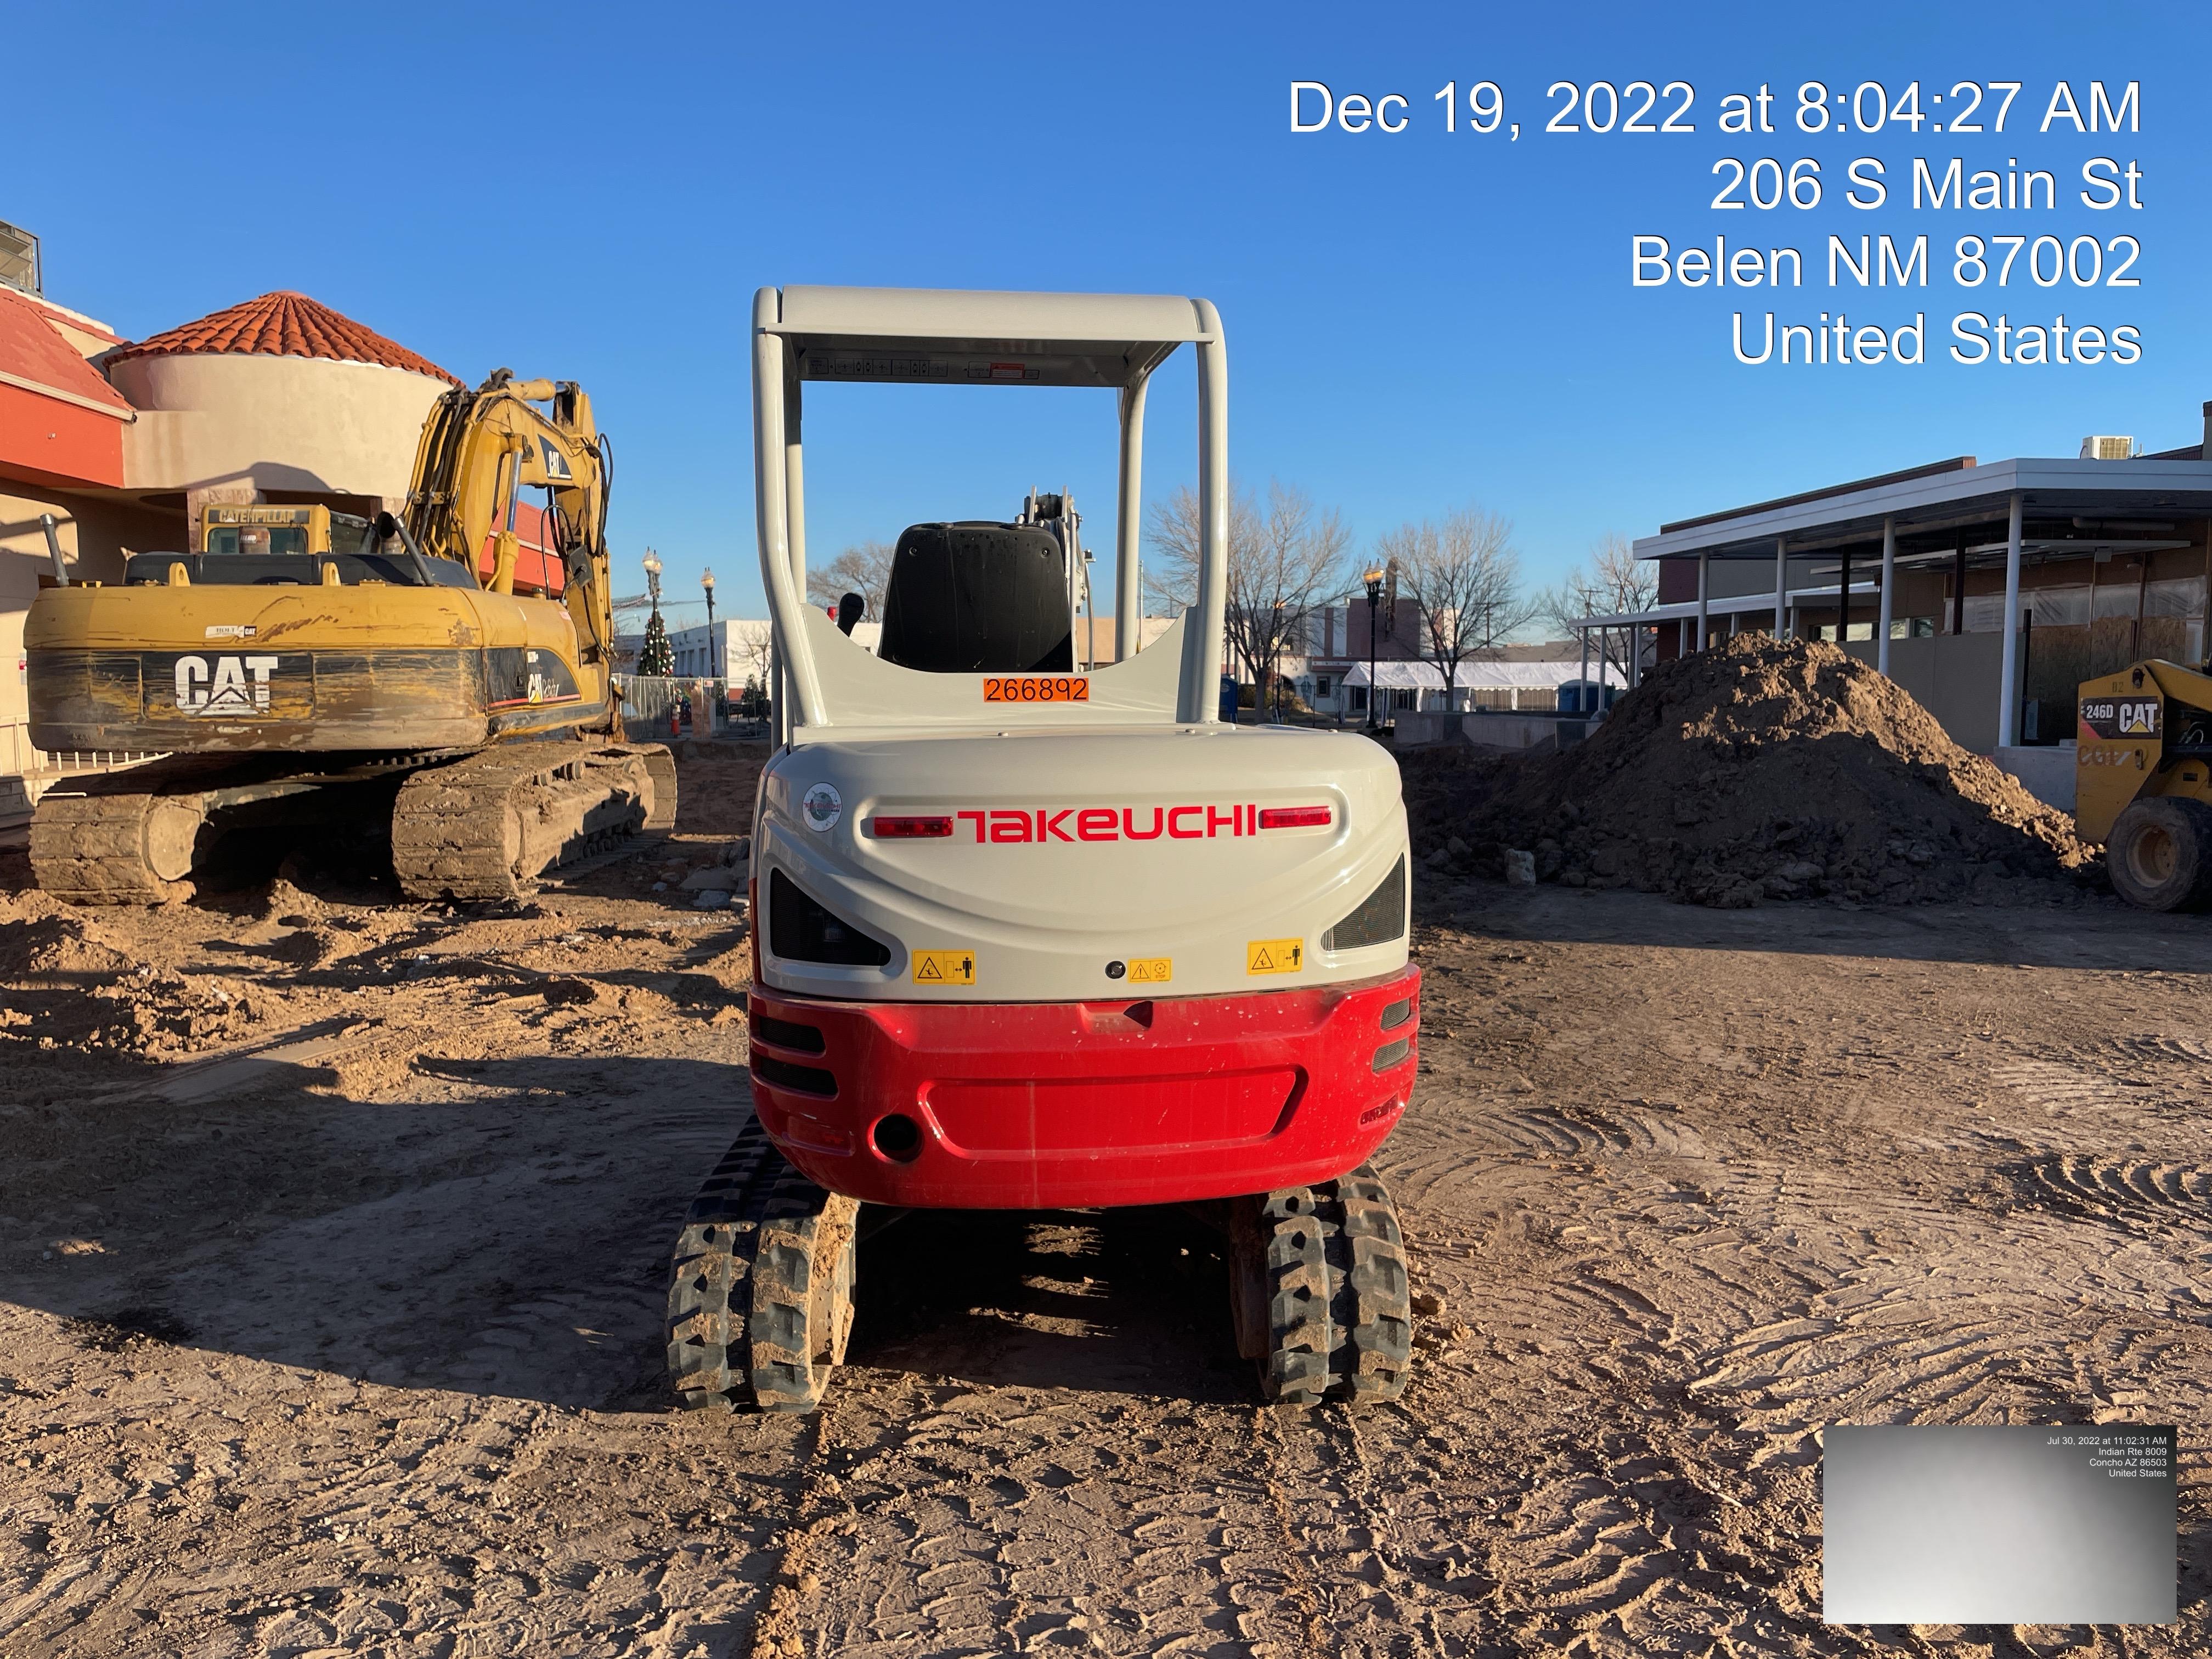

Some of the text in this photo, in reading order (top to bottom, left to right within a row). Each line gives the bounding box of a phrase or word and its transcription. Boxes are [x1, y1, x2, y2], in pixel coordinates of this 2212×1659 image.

[175, 655, 278, 715] CAT
[986, 678, 1087, 701] 266892
[2086, 703, 2158, 733] 246D CAT
